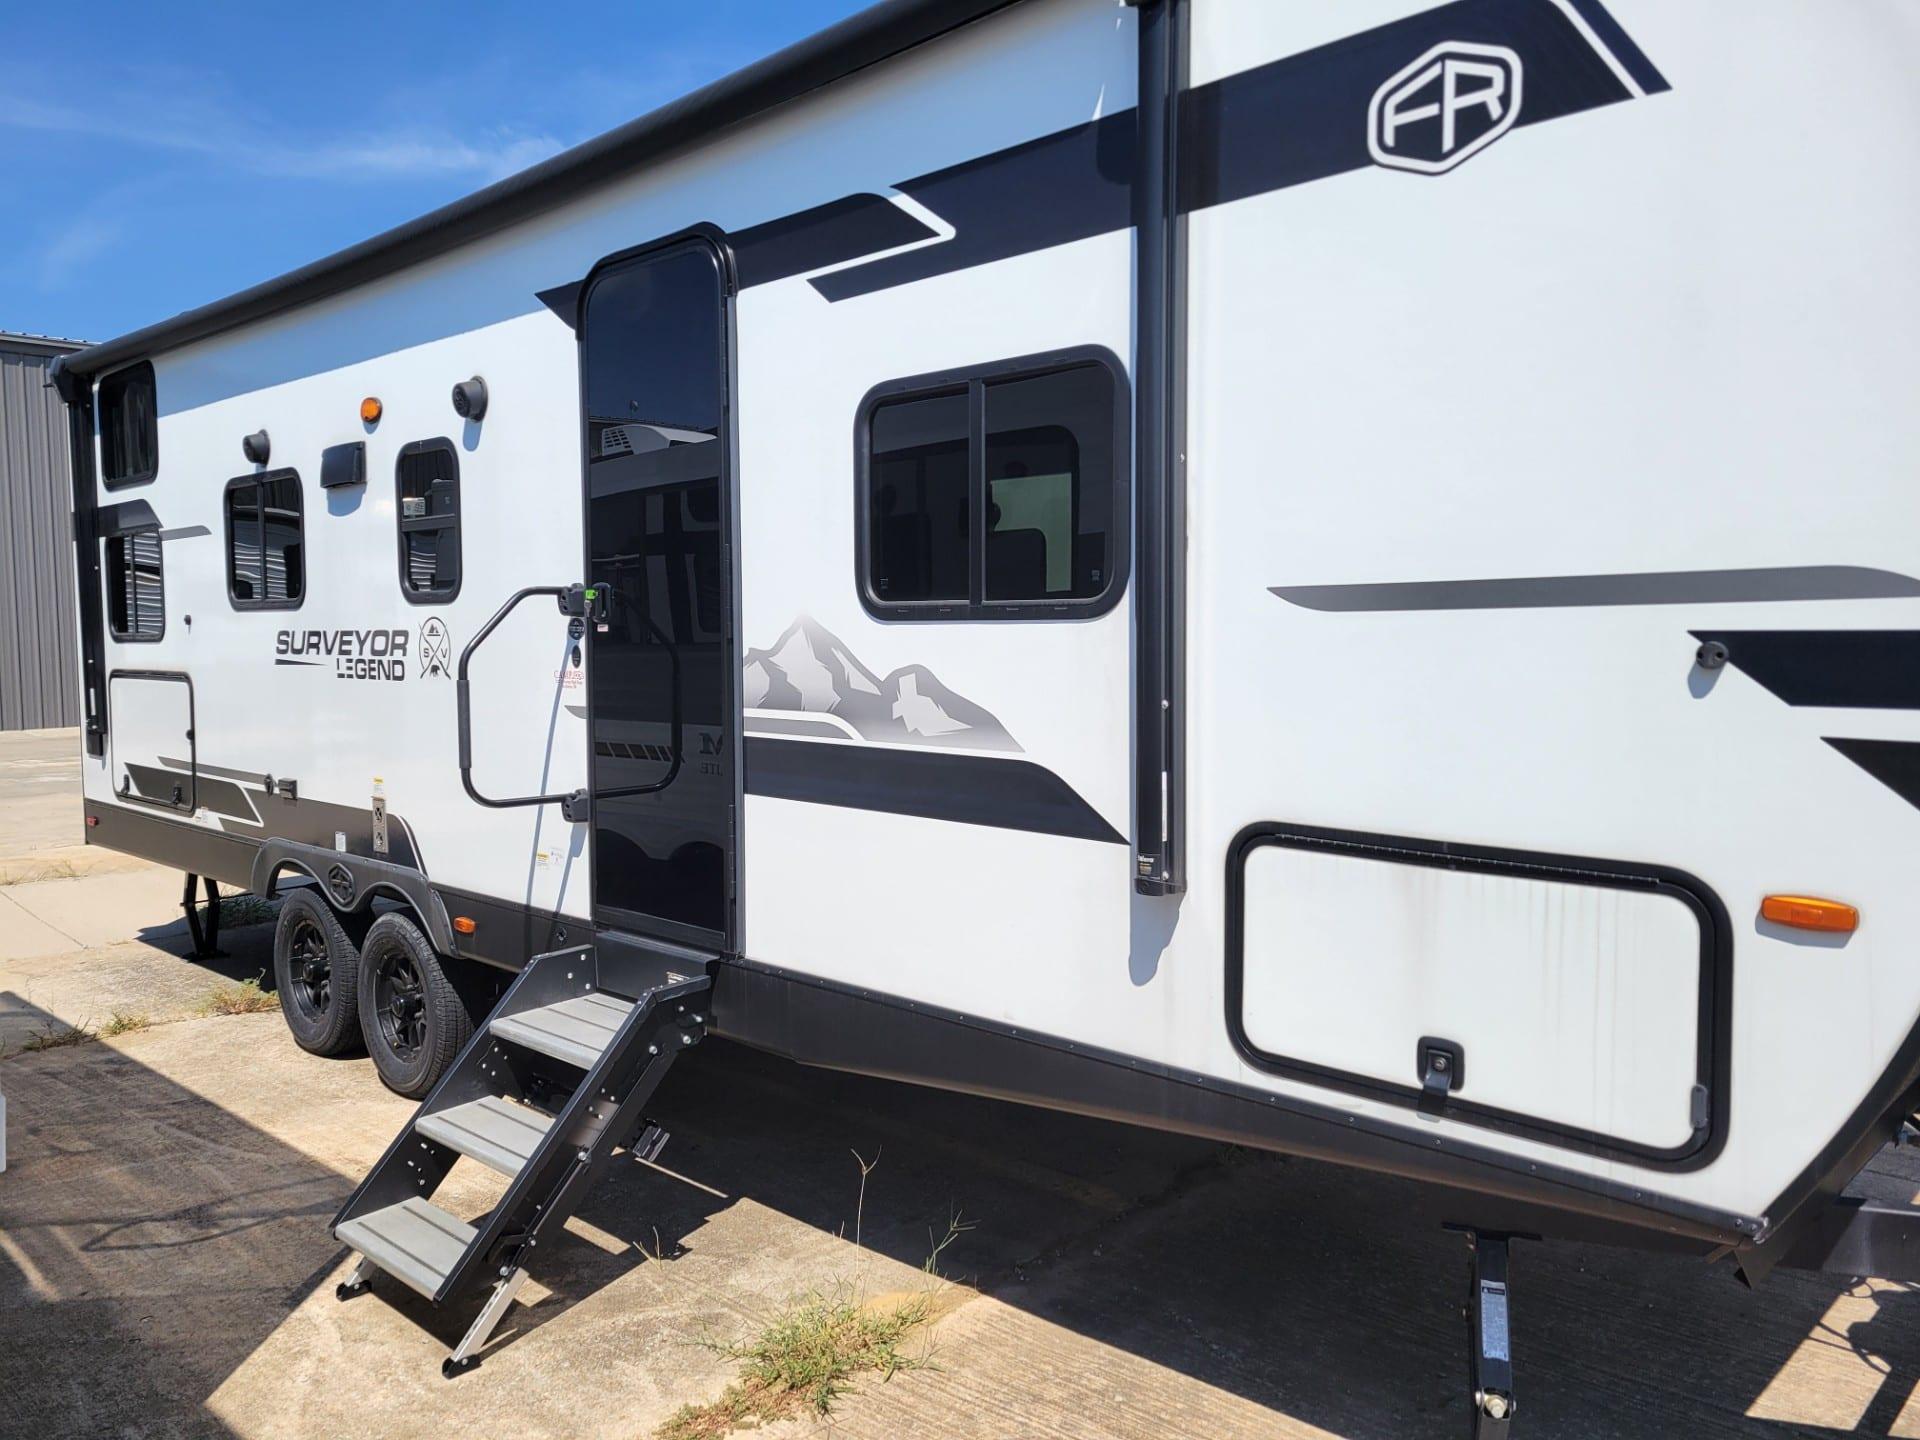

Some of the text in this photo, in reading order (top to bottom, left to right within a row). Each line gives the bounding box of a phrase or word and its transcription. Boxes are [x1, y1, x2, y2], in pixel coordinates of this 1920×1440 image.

[276, 630, 409, 656] SURVEYOR
[423, 647, 448, 659] S V
[336, 658, 405, 681] LEGEND
